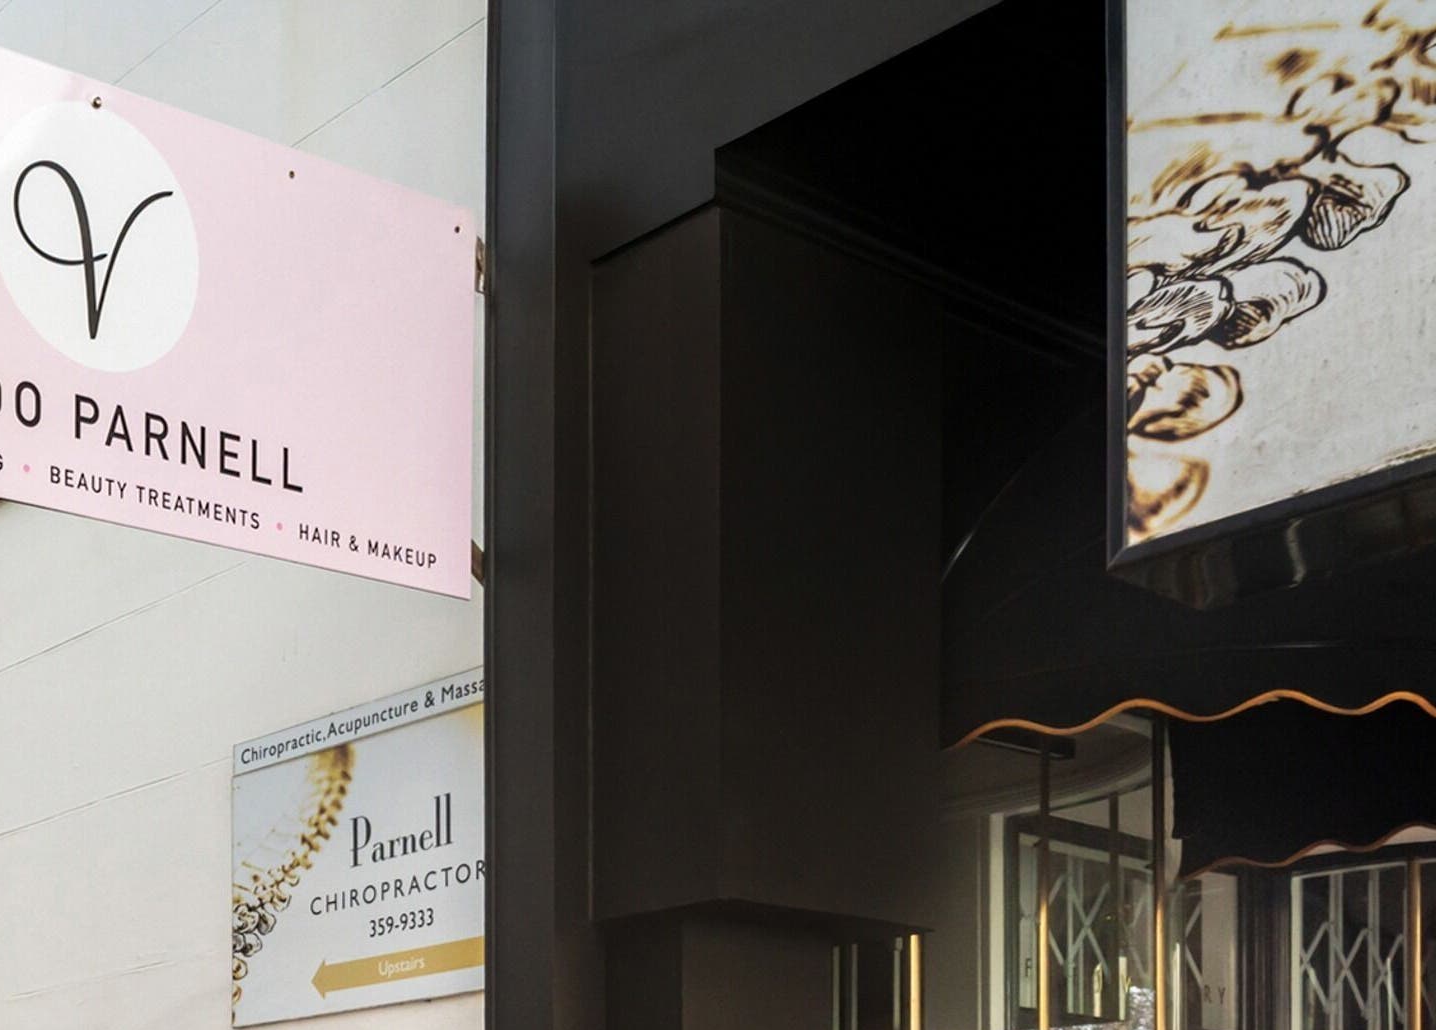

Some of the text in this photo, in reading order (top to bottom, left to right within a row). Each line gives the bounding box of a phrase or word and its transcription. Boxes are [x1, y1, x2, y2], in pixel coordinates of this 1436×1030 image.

[74, 393, 304, 493] PARNELL
[50, 465, 261, 530] BEAUTY TREATMENTS
[299, 523, 437, 570] HAIR & MAKEUP
[424, 691, 435, 708] &
[350, 792, 454, 868] Parnell
[310, 859, 485, 916] CHIROPRACTOR
[369, 907, 435, 938] 359-9333
[377, 956, 425, 978] Upstairs
